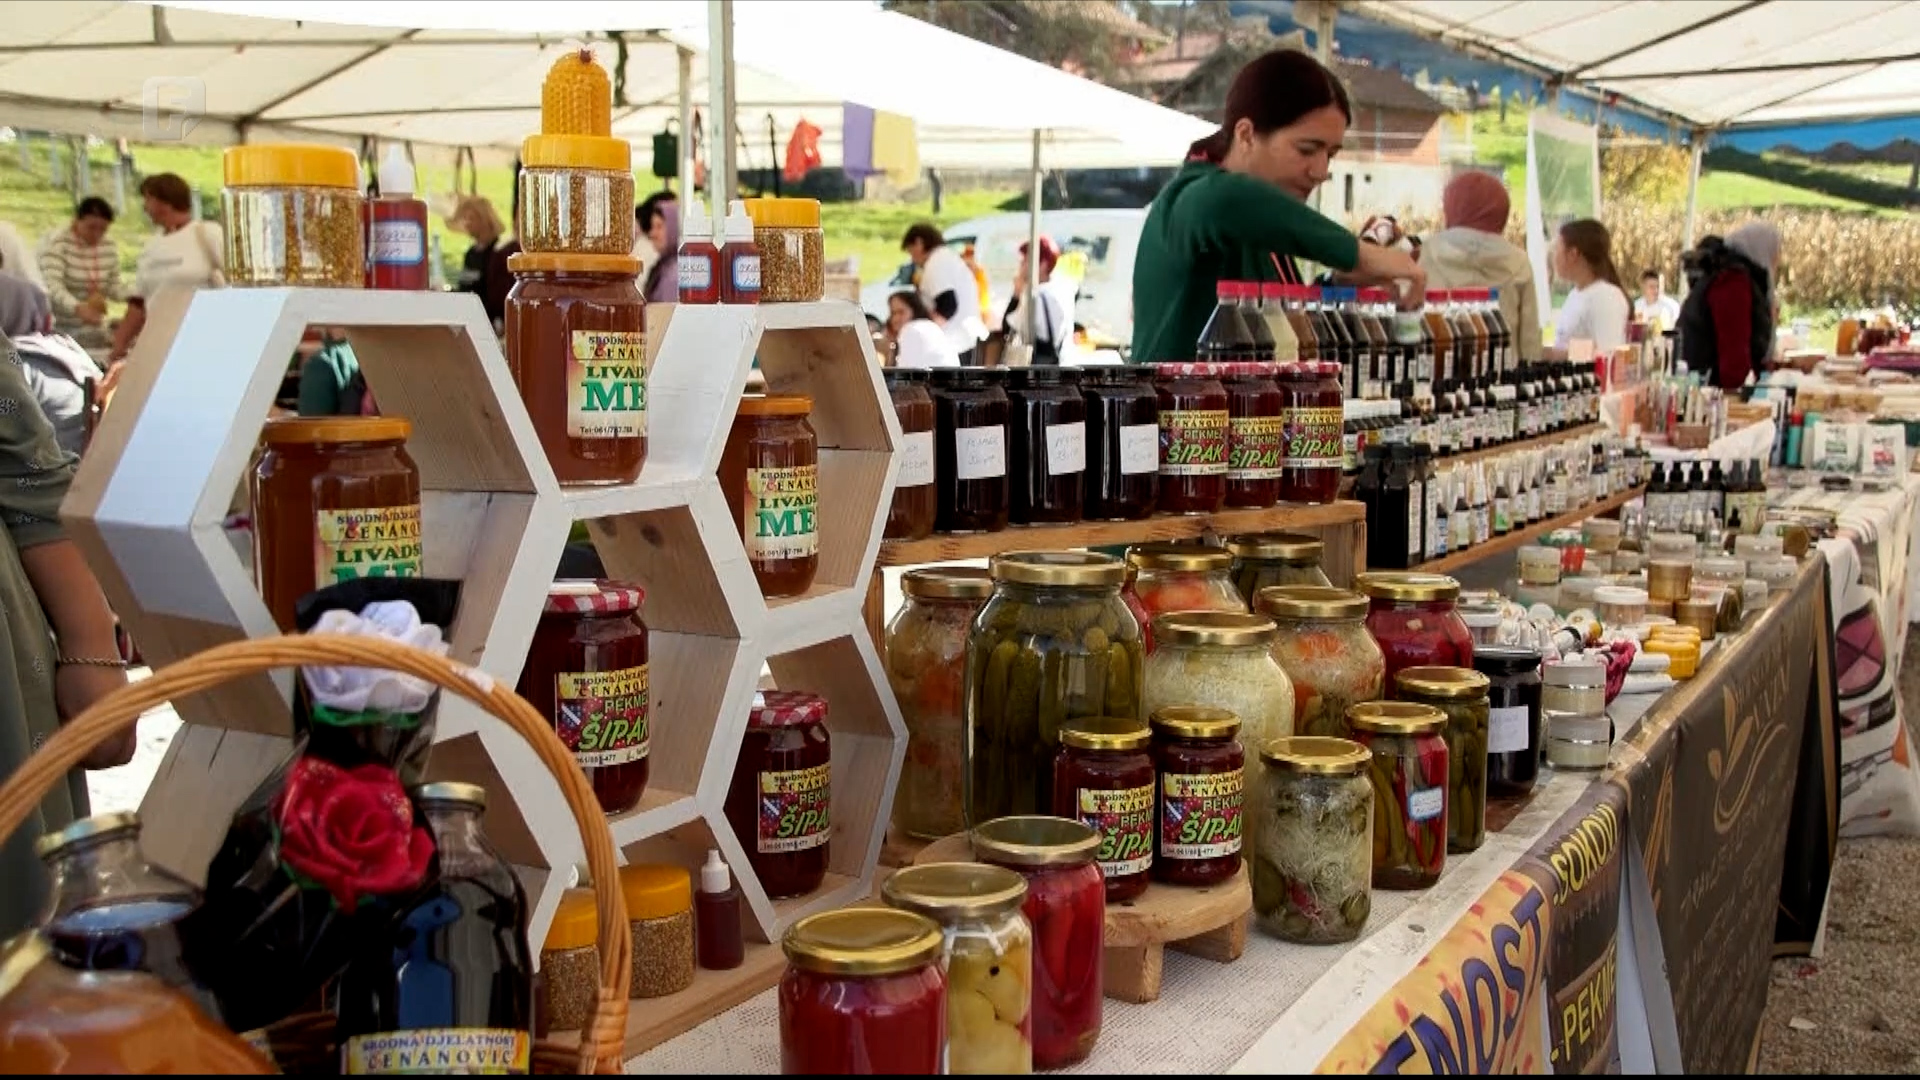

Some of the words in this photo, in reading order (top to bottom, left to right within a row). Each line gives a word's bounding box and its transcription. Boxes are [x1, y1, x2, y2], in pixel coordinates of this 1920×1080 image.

[1167, 438, 1224, 463] ŠIPAK
[1229, 444, 1280, 468] ŠIPAK
[1290, 434, 1339, 457] ŠIPAK
